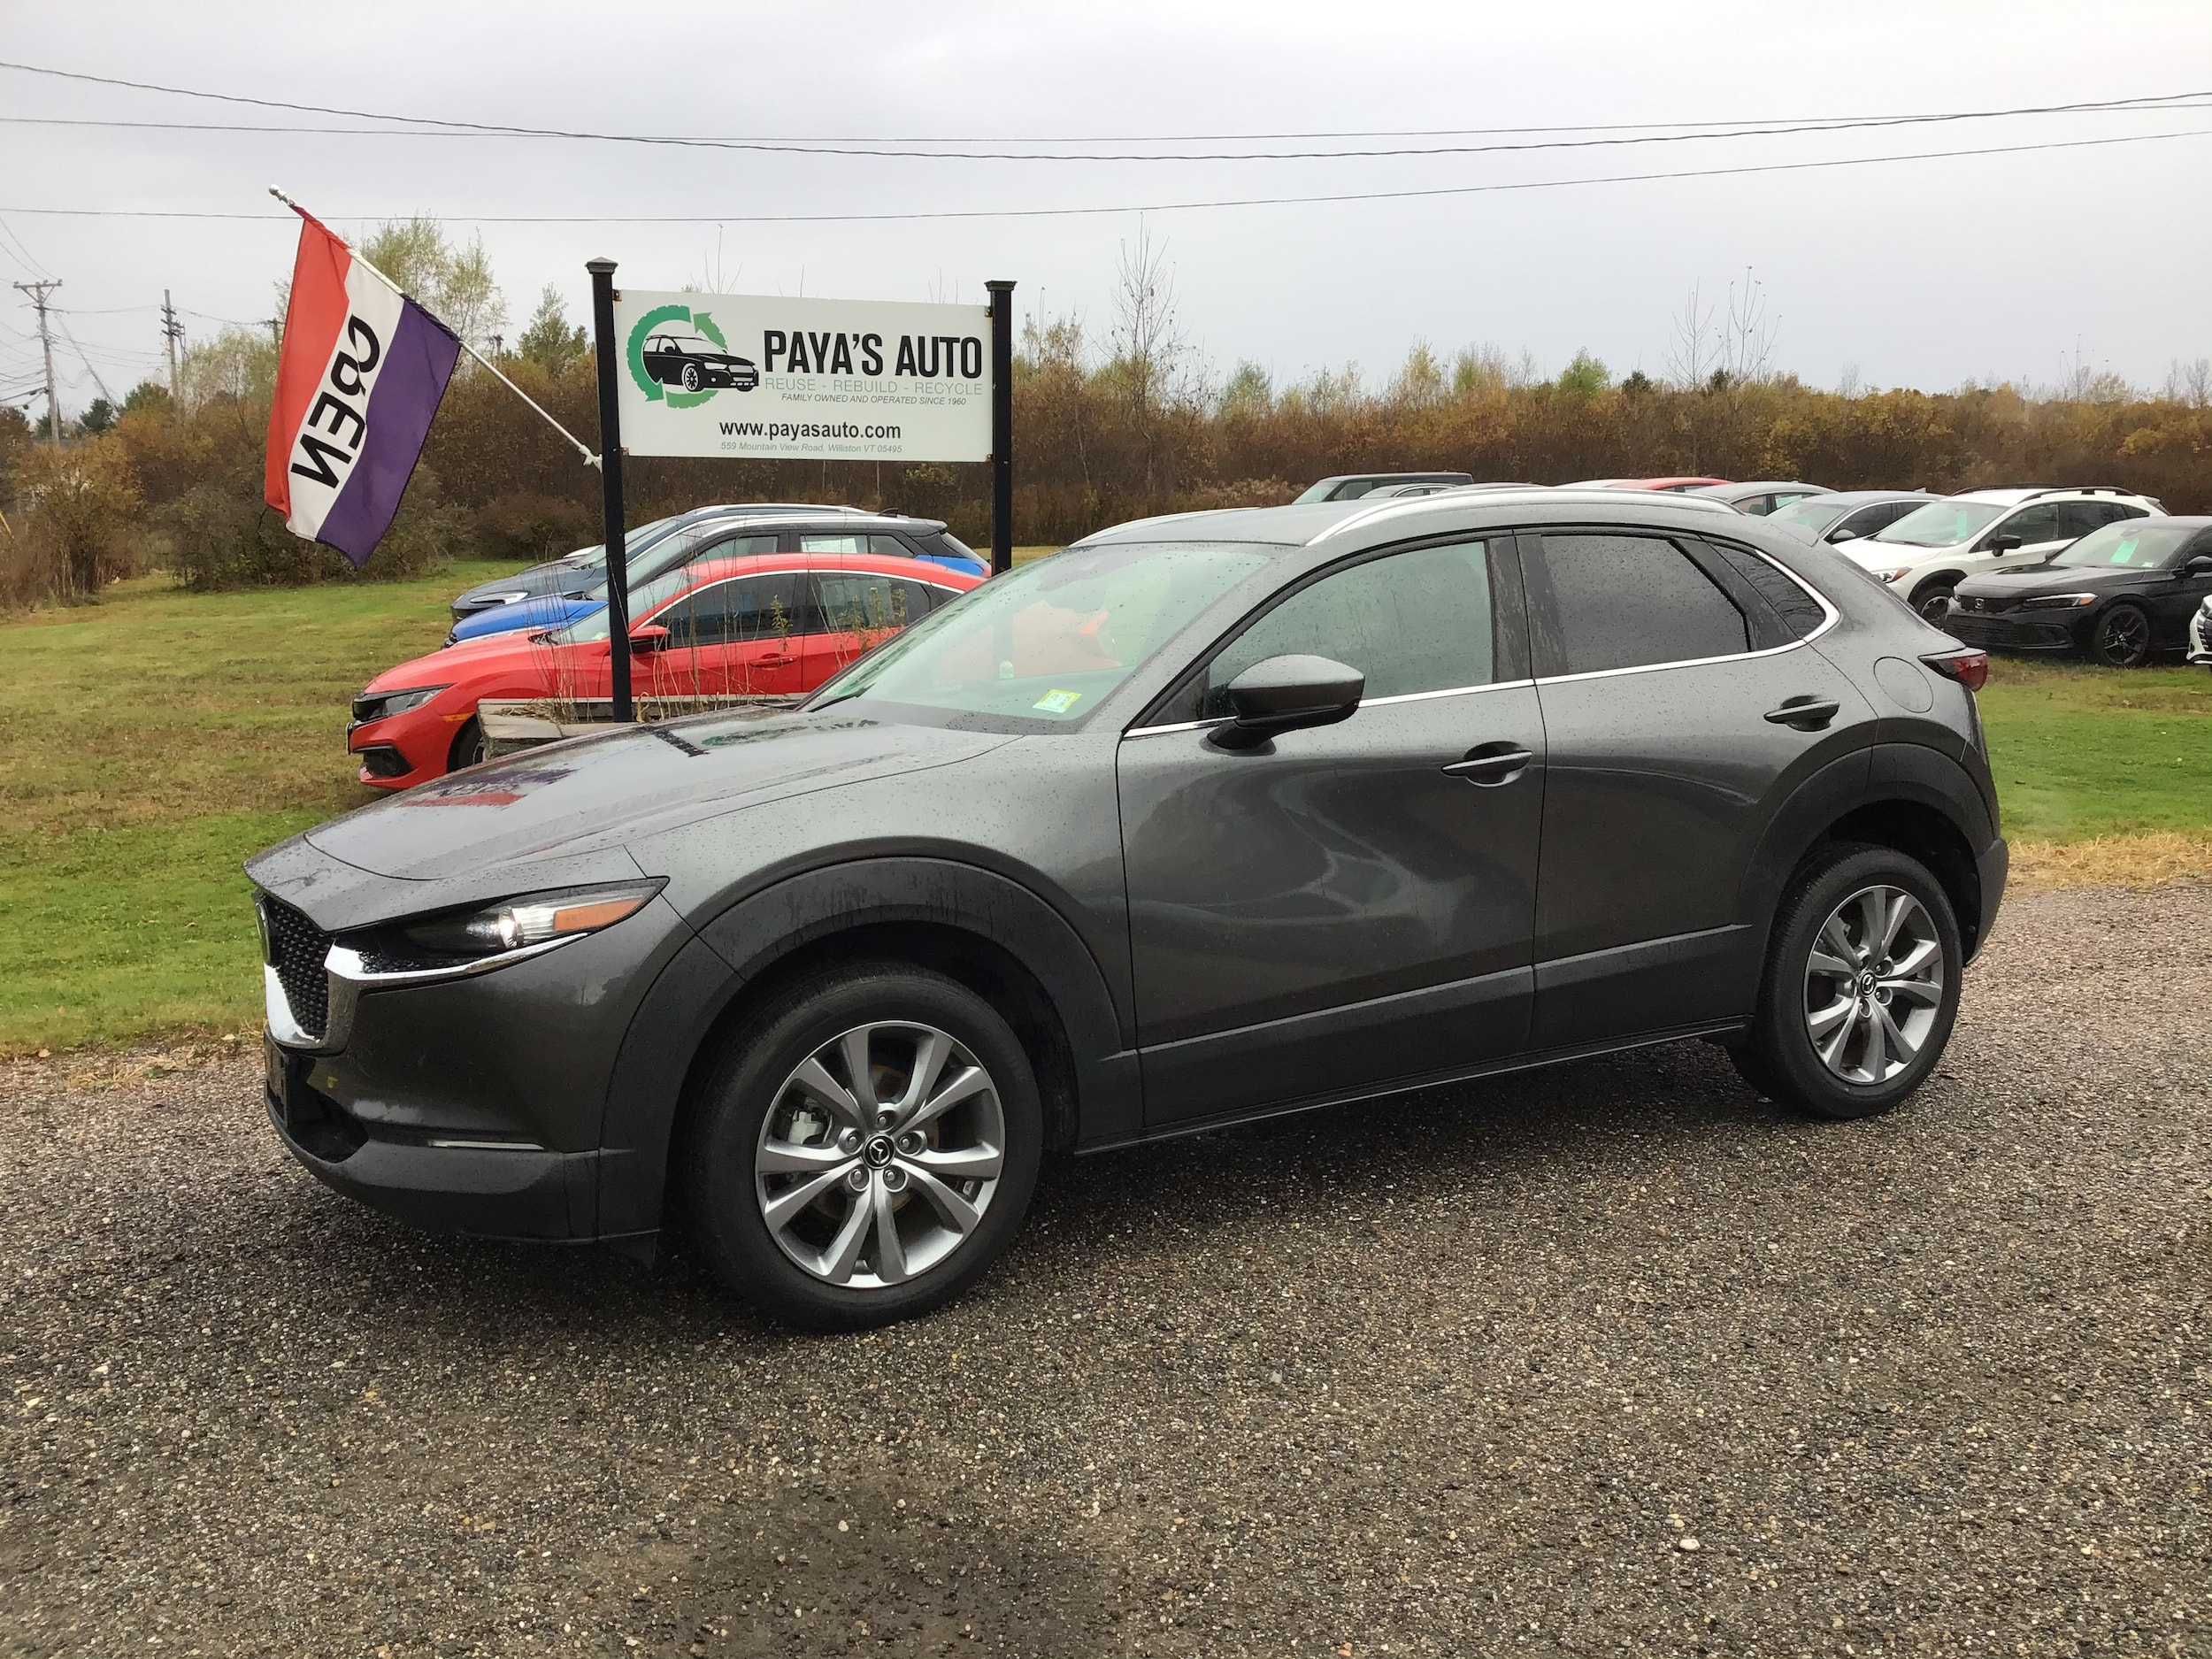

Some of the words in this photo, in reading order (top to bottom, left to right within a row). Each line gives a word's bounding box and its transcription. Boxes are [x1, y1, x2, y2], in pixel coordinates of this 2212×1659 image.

[764, 330, 883, 376] PAYA'S
[895, 335, 982, 379] AUTO
[765, 377, 816, 390] REUSE
[833, 380, 898, 394] REBUILD
[915, 381, 982, 396] RECYCLE
[781, 393, 812, 402] FAMILY
[814, 394, 849, 403] OWNED
[849, 395, 869, 403] AND
[871, 396, 918, 404] OPERATED
[719, 421, 901, 442] www.payasauto.com
[721, 442, 737, 450] 559
[739, 442, 777, 451] Mountain
[780, 442, 800, 451] View
[801, 442, 825, 452] Road,
[828, 443, 862, 452] Williston
[877, 444, 902, 453] 05495
